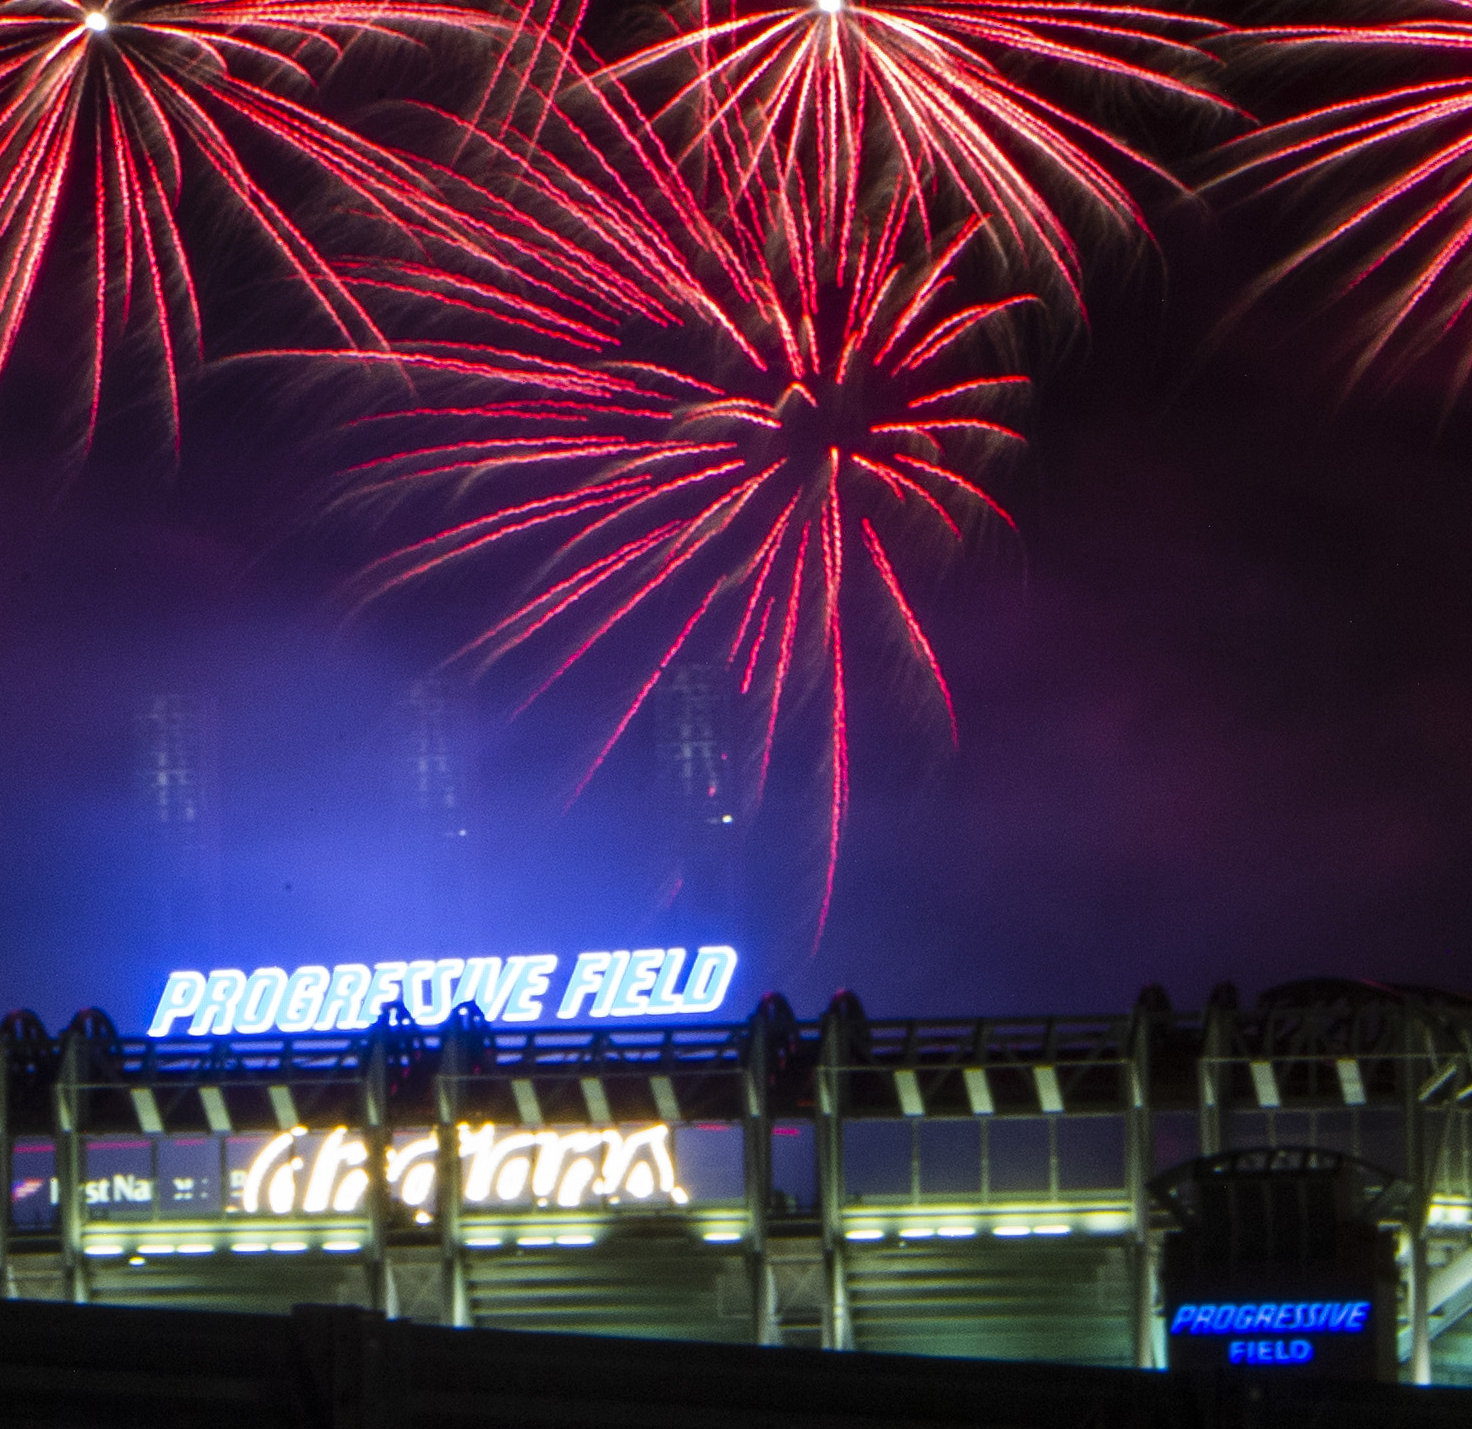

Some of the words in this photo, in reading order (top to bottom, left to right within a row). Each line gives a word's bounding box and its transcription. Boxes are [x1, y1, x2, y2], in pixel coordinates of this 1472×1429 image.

[147, 954, 557, 1038] PROGRESSIVE
[557, 946, 737, 1019] FIELD
[1170, 1301, 1373, 1335] PROGRESSIVE
[1229, 1339, 1315, 1364] FIELD
